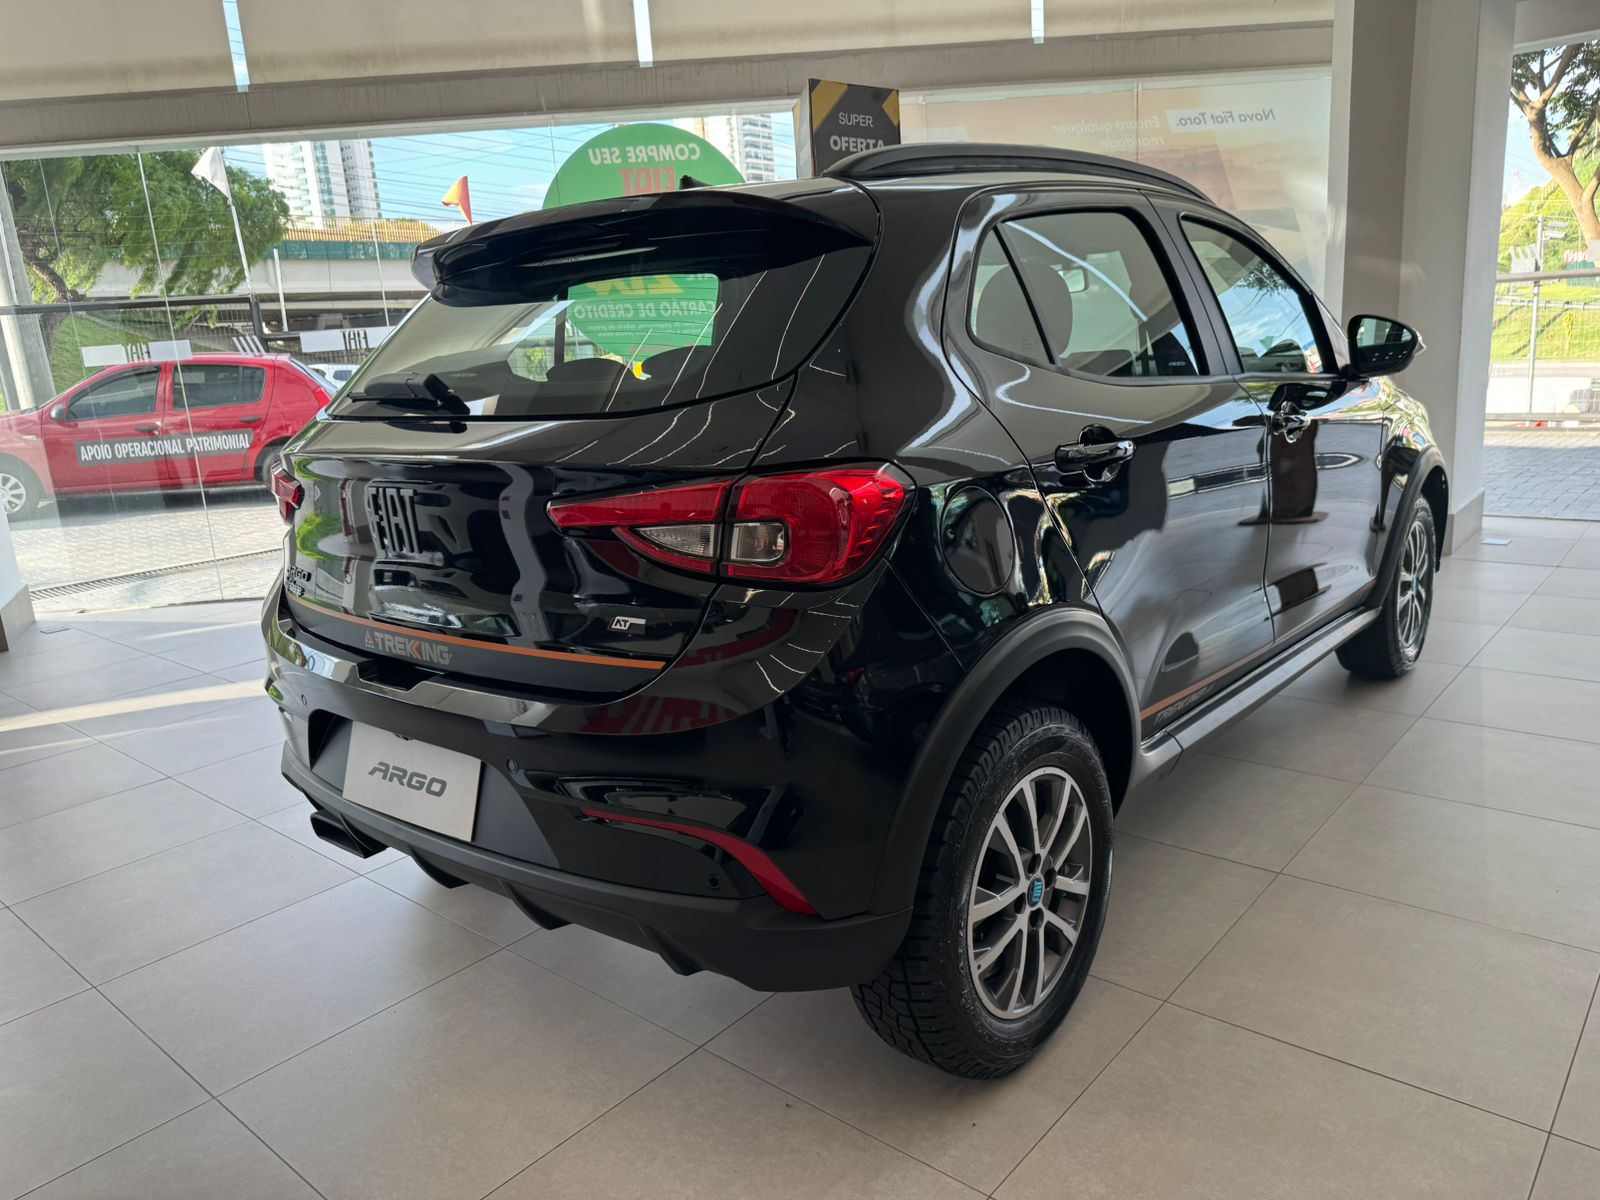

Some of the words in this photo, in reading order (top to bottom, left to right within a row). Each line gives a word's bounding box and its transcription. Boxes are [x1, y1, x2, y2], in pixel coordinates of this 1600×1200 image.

[838, 111, 874, 128] SUPER
[80, 443, 112, 462] APOIO
[114, 437, 185, 459] OPERACIONAL
[186, 433, 251, 453] PATRIMONIAL
[367, 487, 422, 558] FIAT
[367, 761, 448, 798] ARGO
